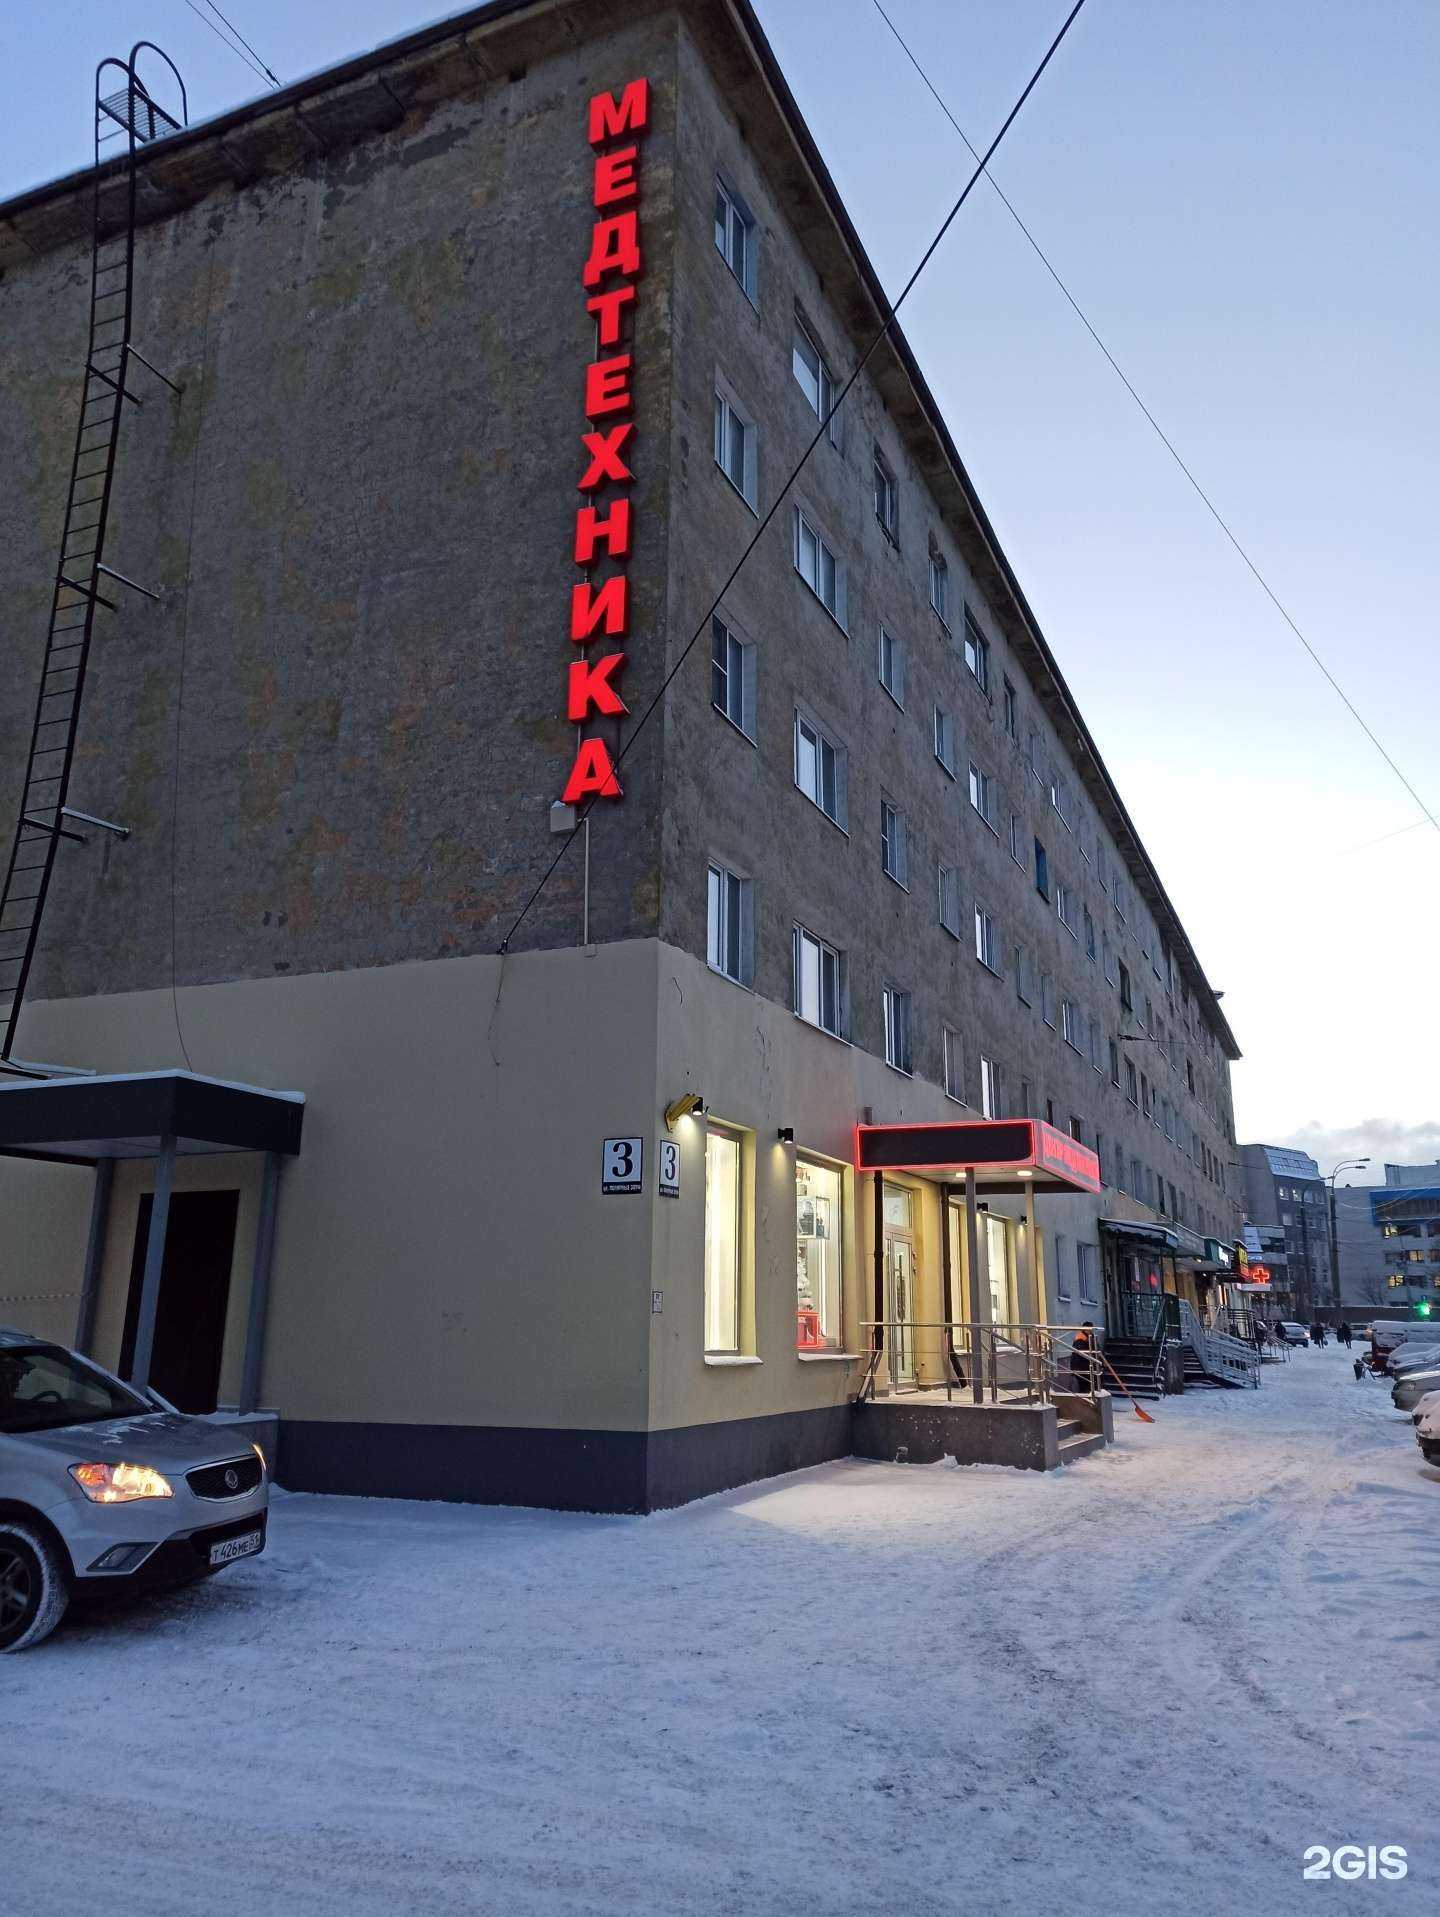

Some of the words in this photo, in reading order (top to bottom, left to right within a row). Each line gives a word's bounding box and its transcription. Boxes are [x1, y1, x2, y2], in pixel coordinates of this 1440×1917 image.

[561, 77, 652, 805] МЕДТЕХНИКА
[612, 1141, 633, 1177] 3
[664, 1145, 676, 1180] 3
